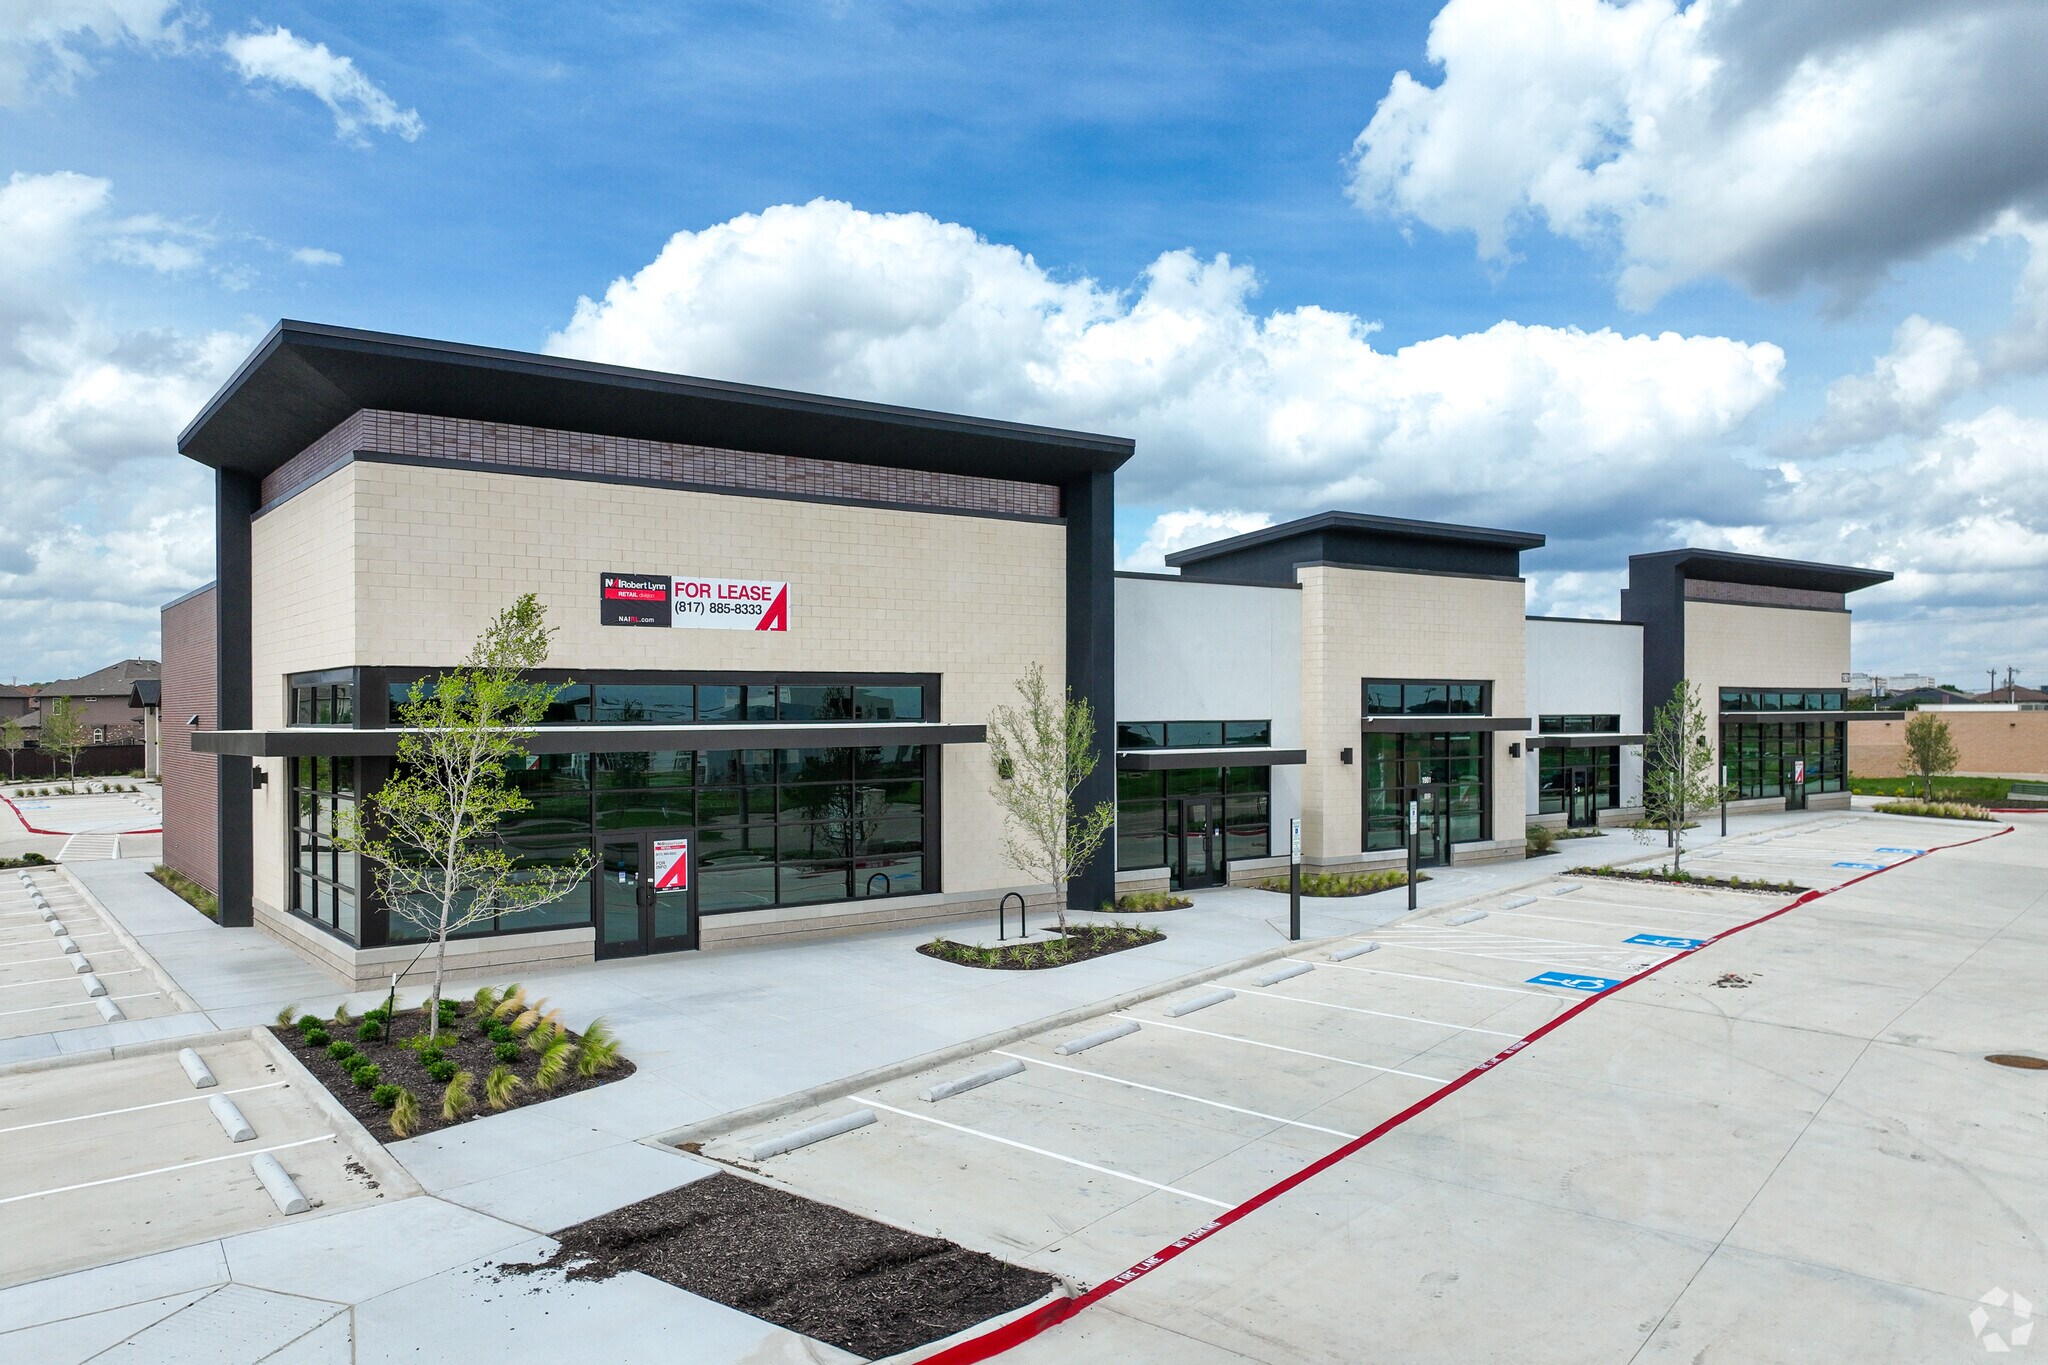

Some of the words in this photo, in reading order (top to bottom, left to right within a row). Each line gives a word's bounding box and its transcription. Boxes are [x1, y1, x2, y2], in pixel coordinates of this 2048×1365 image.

[648, 582, 666, 591] Lynn
[675, 582, 711, 598] FOR
[718, 584, 772, 601] LEASE
[675, 601, 705, 616] (817)
[709, 602, 762, 615] 885-8333
[1114, 1271, 1140, 1283] FIRE
[1136, 1256, 1164, 1270] LANE
